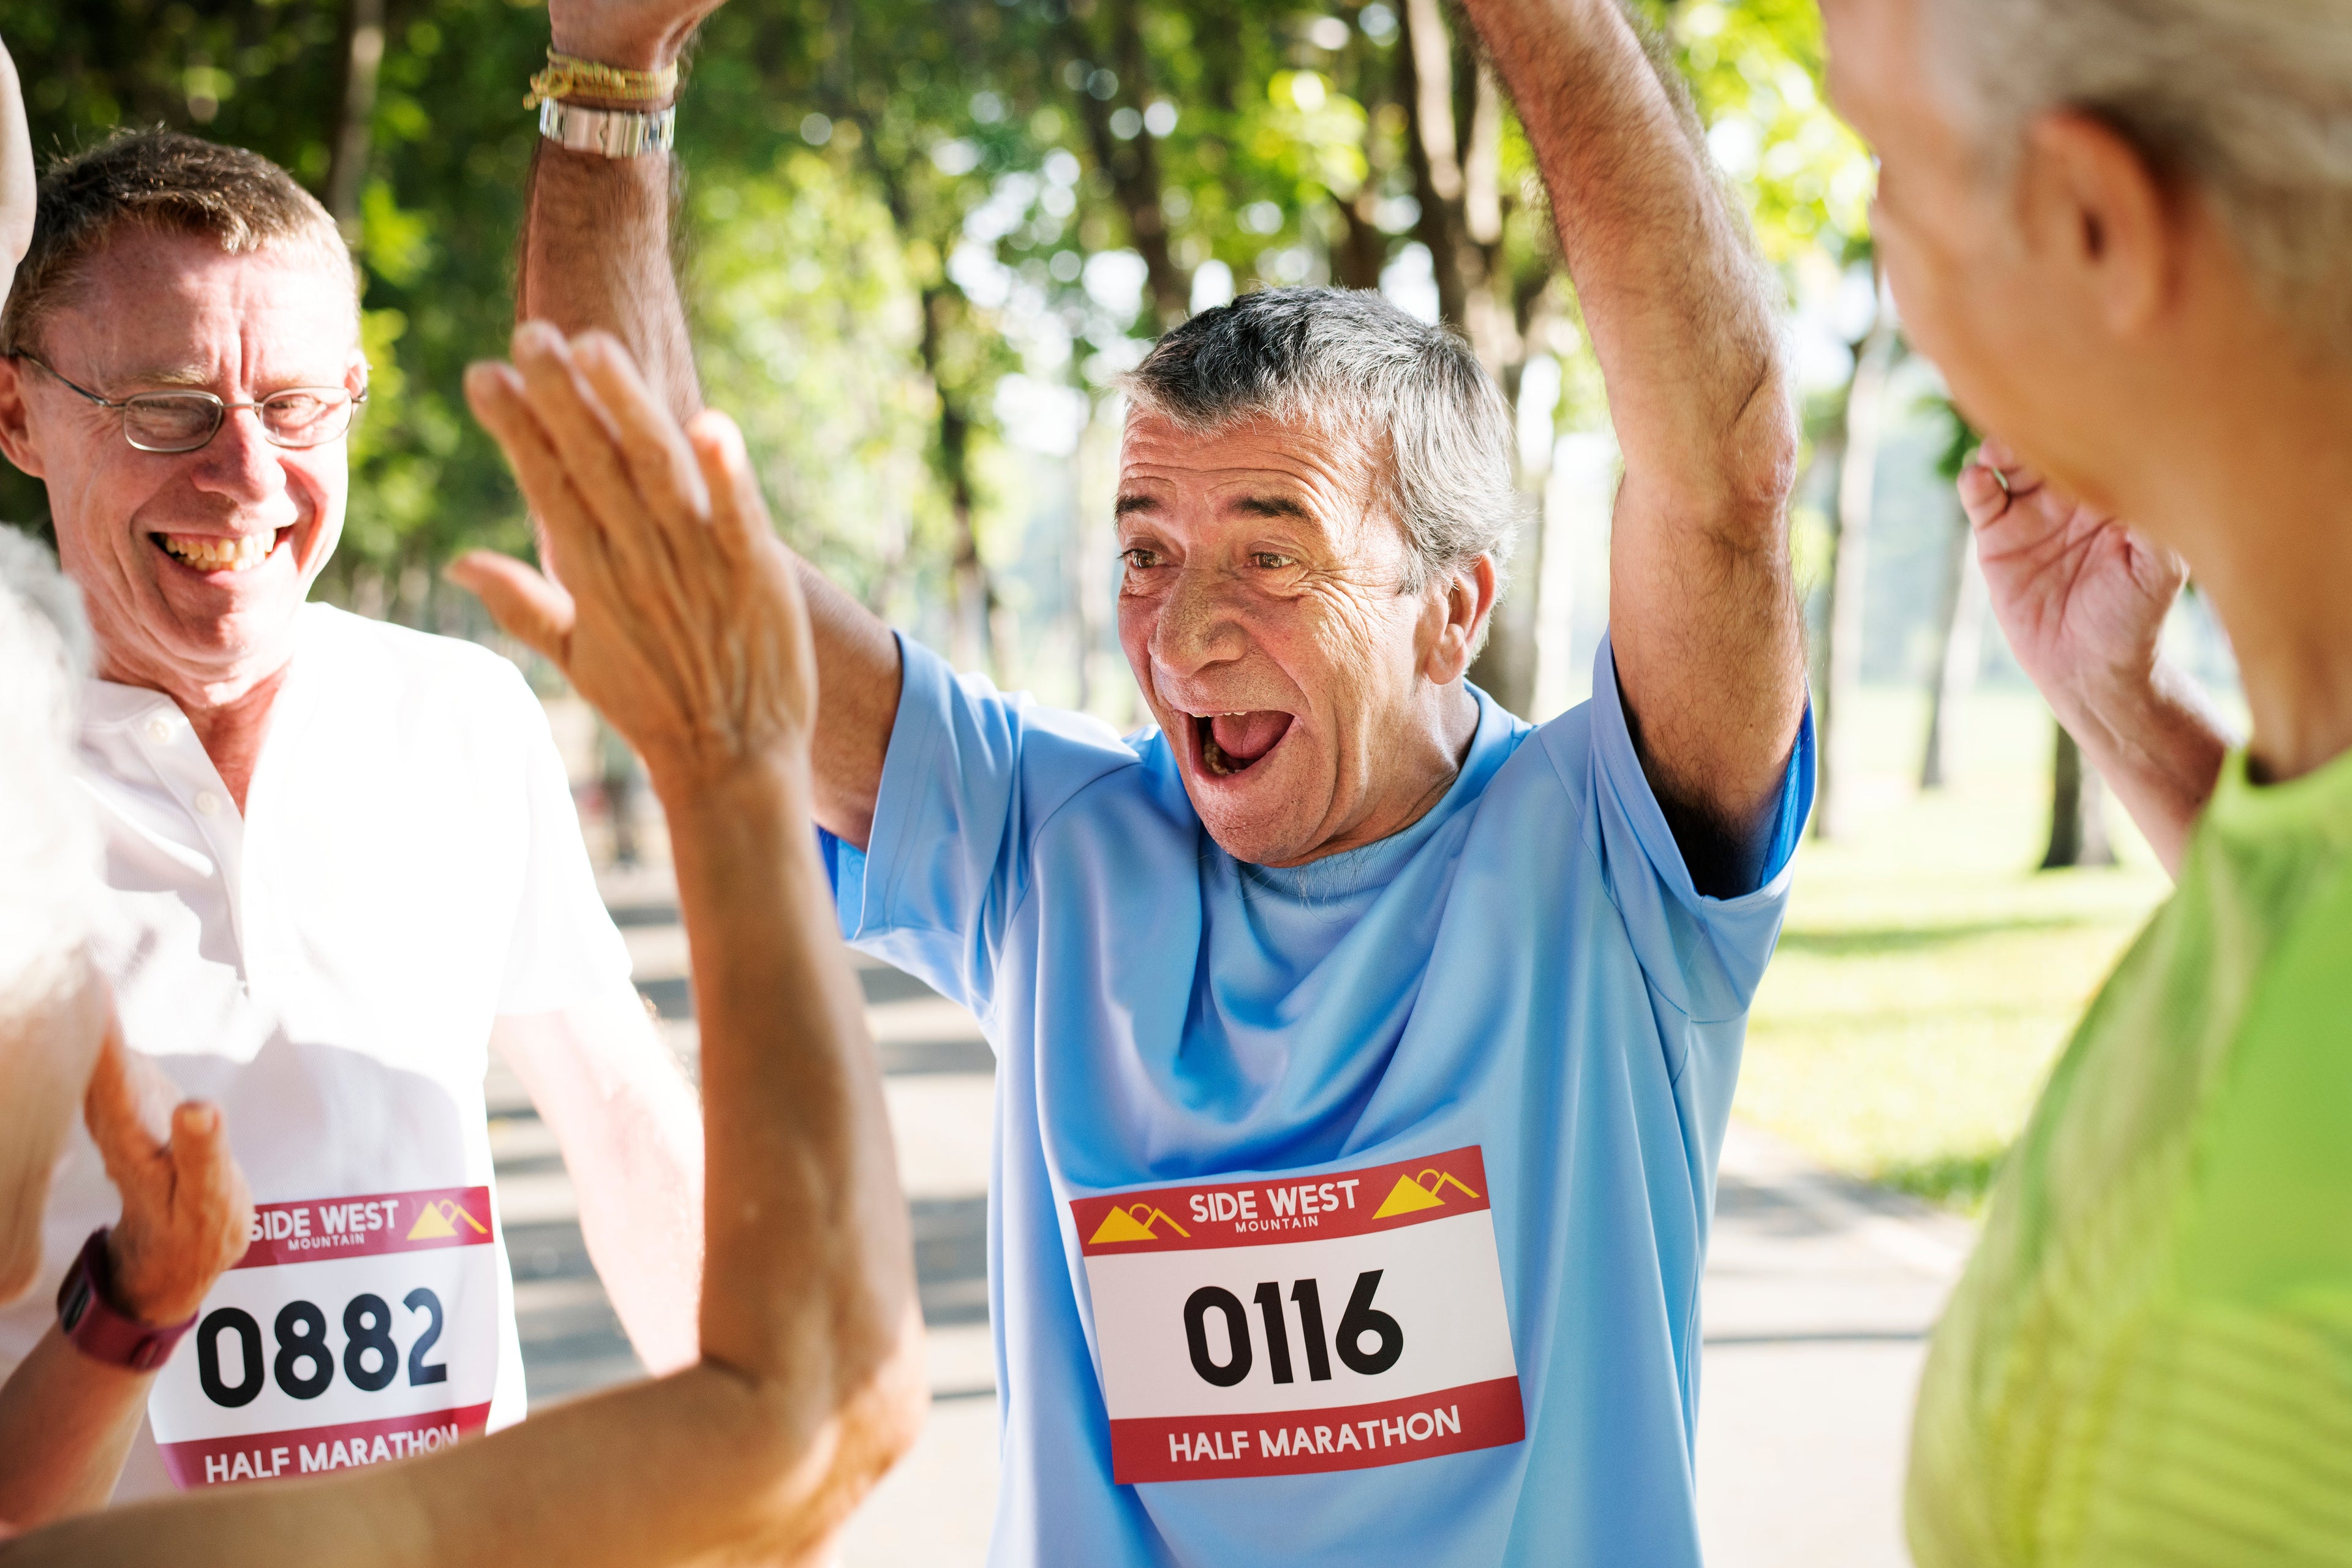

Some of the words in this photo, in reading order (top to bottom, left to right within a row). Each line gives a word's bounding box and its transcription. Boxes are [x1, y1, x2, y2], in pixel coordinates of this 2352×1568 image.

[249, 1207, 310, 1242] SIDE
[319, 1200, 399, 1236] WEST
[1189, 1190, 1257, 1223] SIDE
[1266, 1178, 1360, 1218] WEST
[1235, 1215, 1319, 1234] MOUNTAIN
[288, 1234, 365, 1251] MOUNTAIN
[197, 1287, 447, 1409] 0882
[1183, 1268, 1404, 1387] 0116
[205, 1447, 290, 1483] HALF
[299, 1423, 459, 1473] MARATHON
[1169, 1430, 1250, 1463] HALF
[1259, 1405, 1461, 1458] MARATHON
